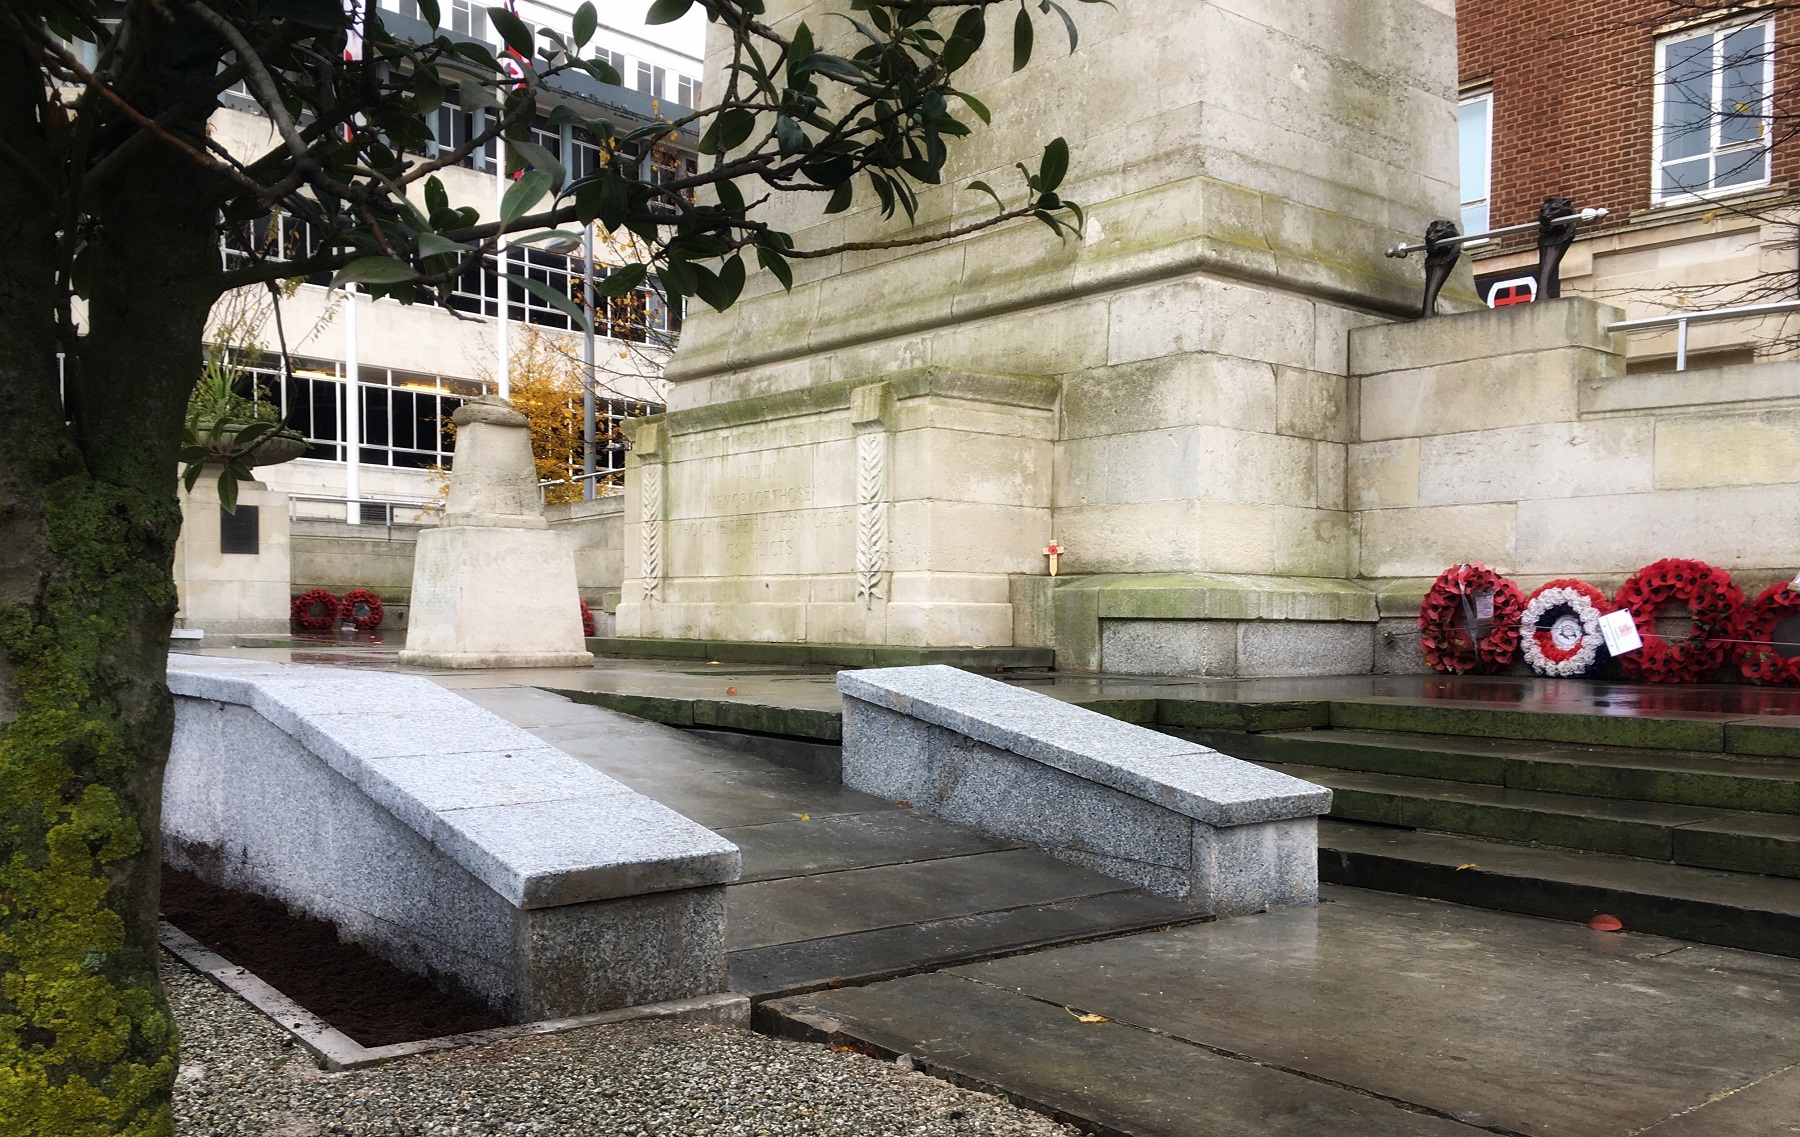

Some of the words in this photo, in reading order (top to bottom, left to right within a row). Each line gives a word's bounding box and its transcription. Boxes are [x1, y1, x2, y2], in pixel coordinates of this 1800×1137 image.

[737, 464, 761, 481] AND
[709, 491, 753, 510] MEMORY
[754, 490, 770, 507] OF
[770, 486, 812, 505] THOSE
[700, 520, 726, 537] GAVE
[728, 517, 759, 534] THEIR
[762, 514, 797, 532] LIVES
[726, 539, 793, 559] CONFLICTS
